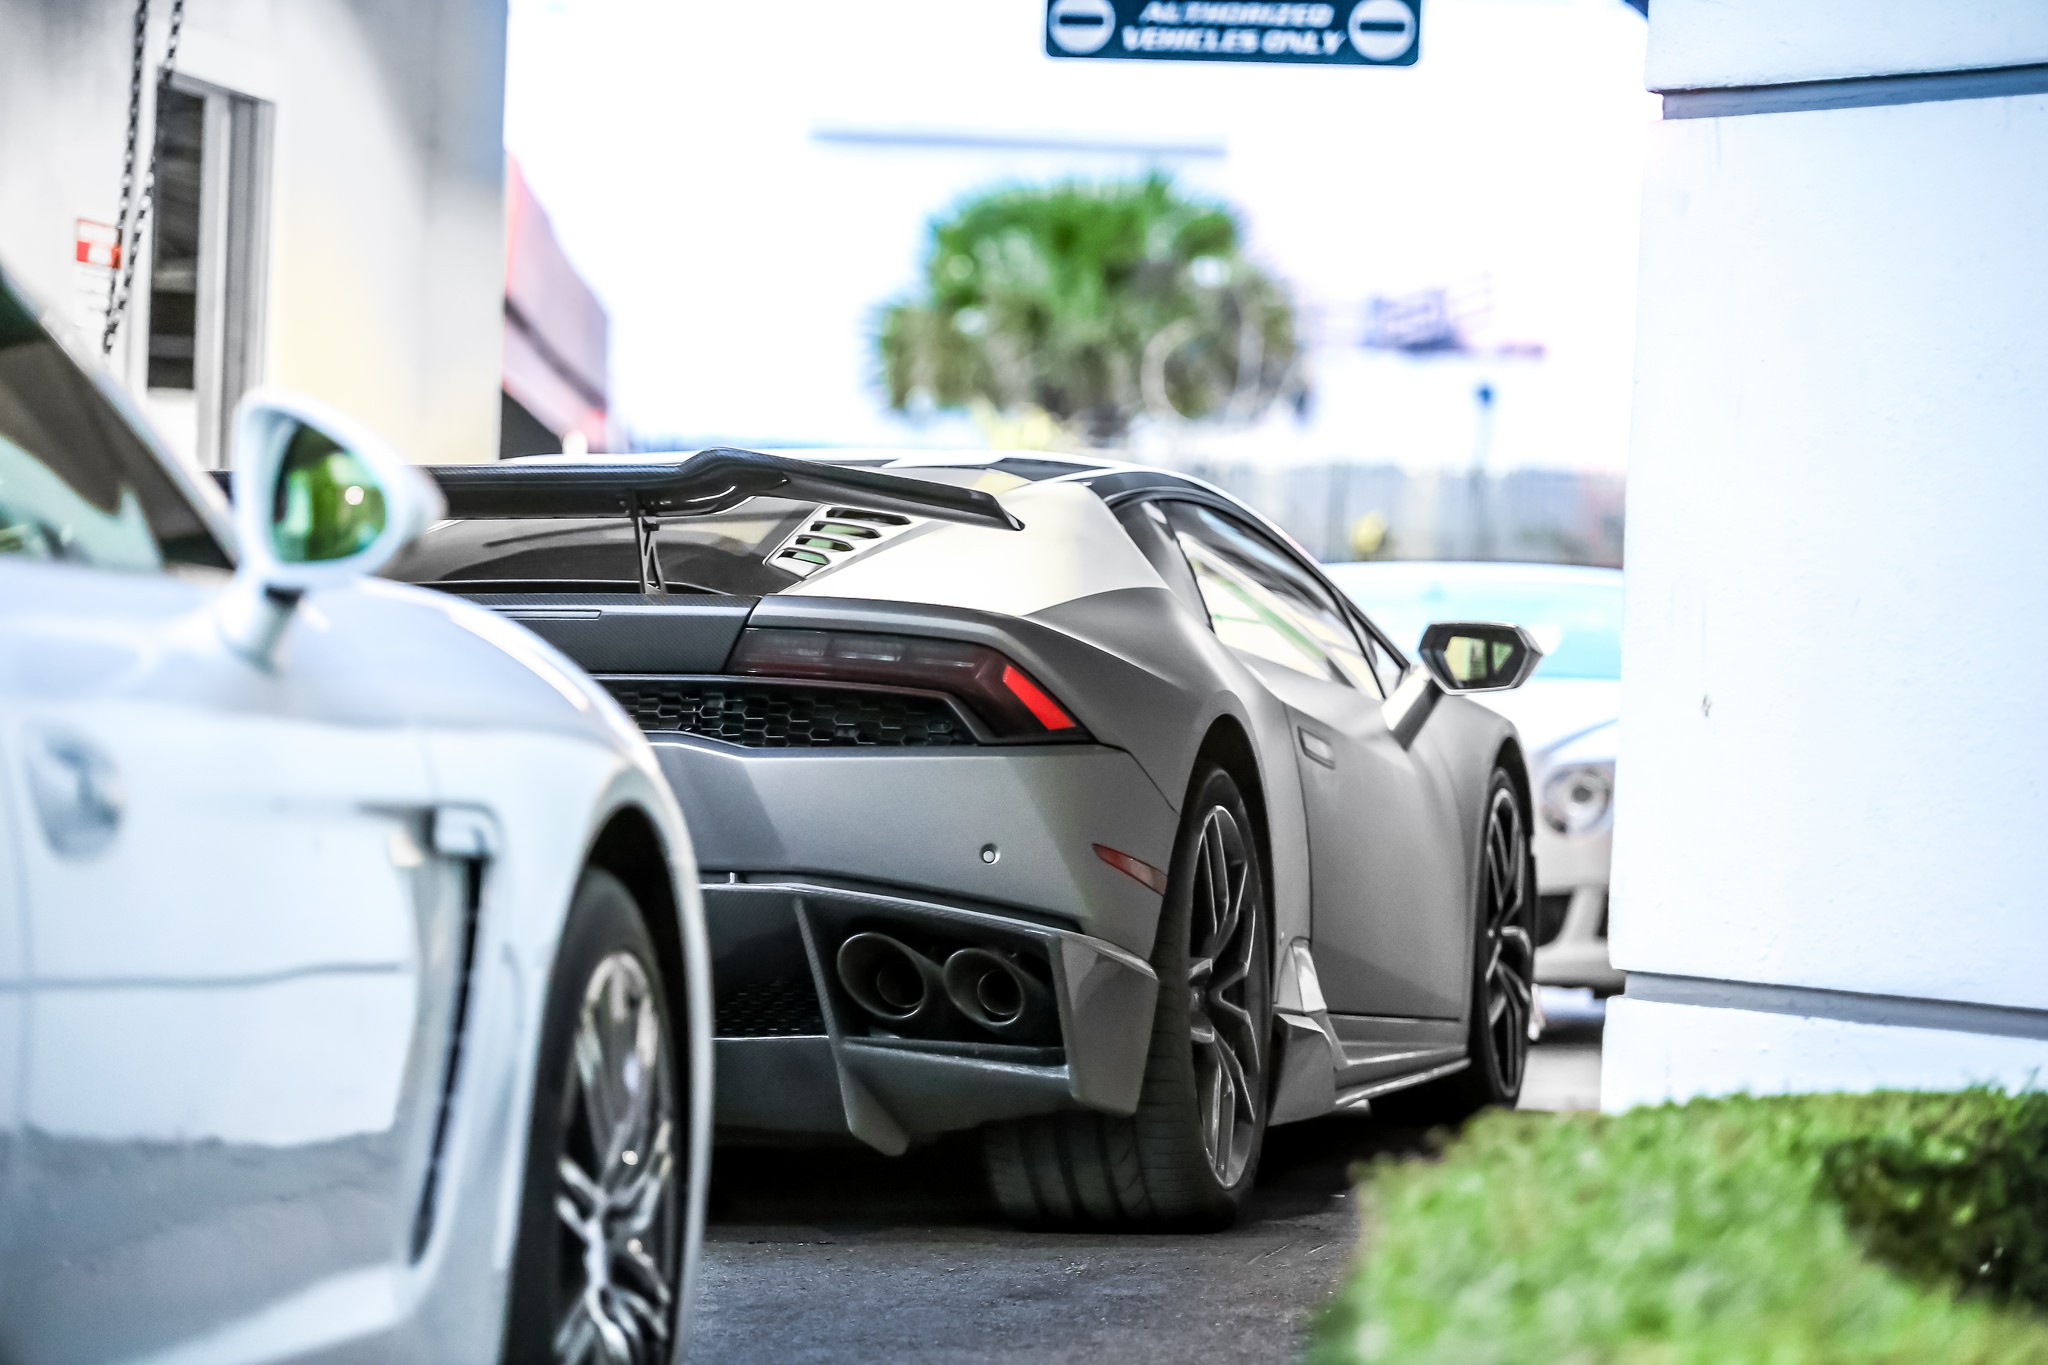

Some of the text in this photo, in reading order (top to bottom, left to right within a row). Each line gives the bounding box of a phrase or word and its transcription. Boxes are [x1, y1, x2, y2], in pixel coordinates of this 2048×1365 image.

[1139, 1, 1335, 27] AUTHORIZED
[1122, 26, 1347, 55] VEHICLES ONLY
